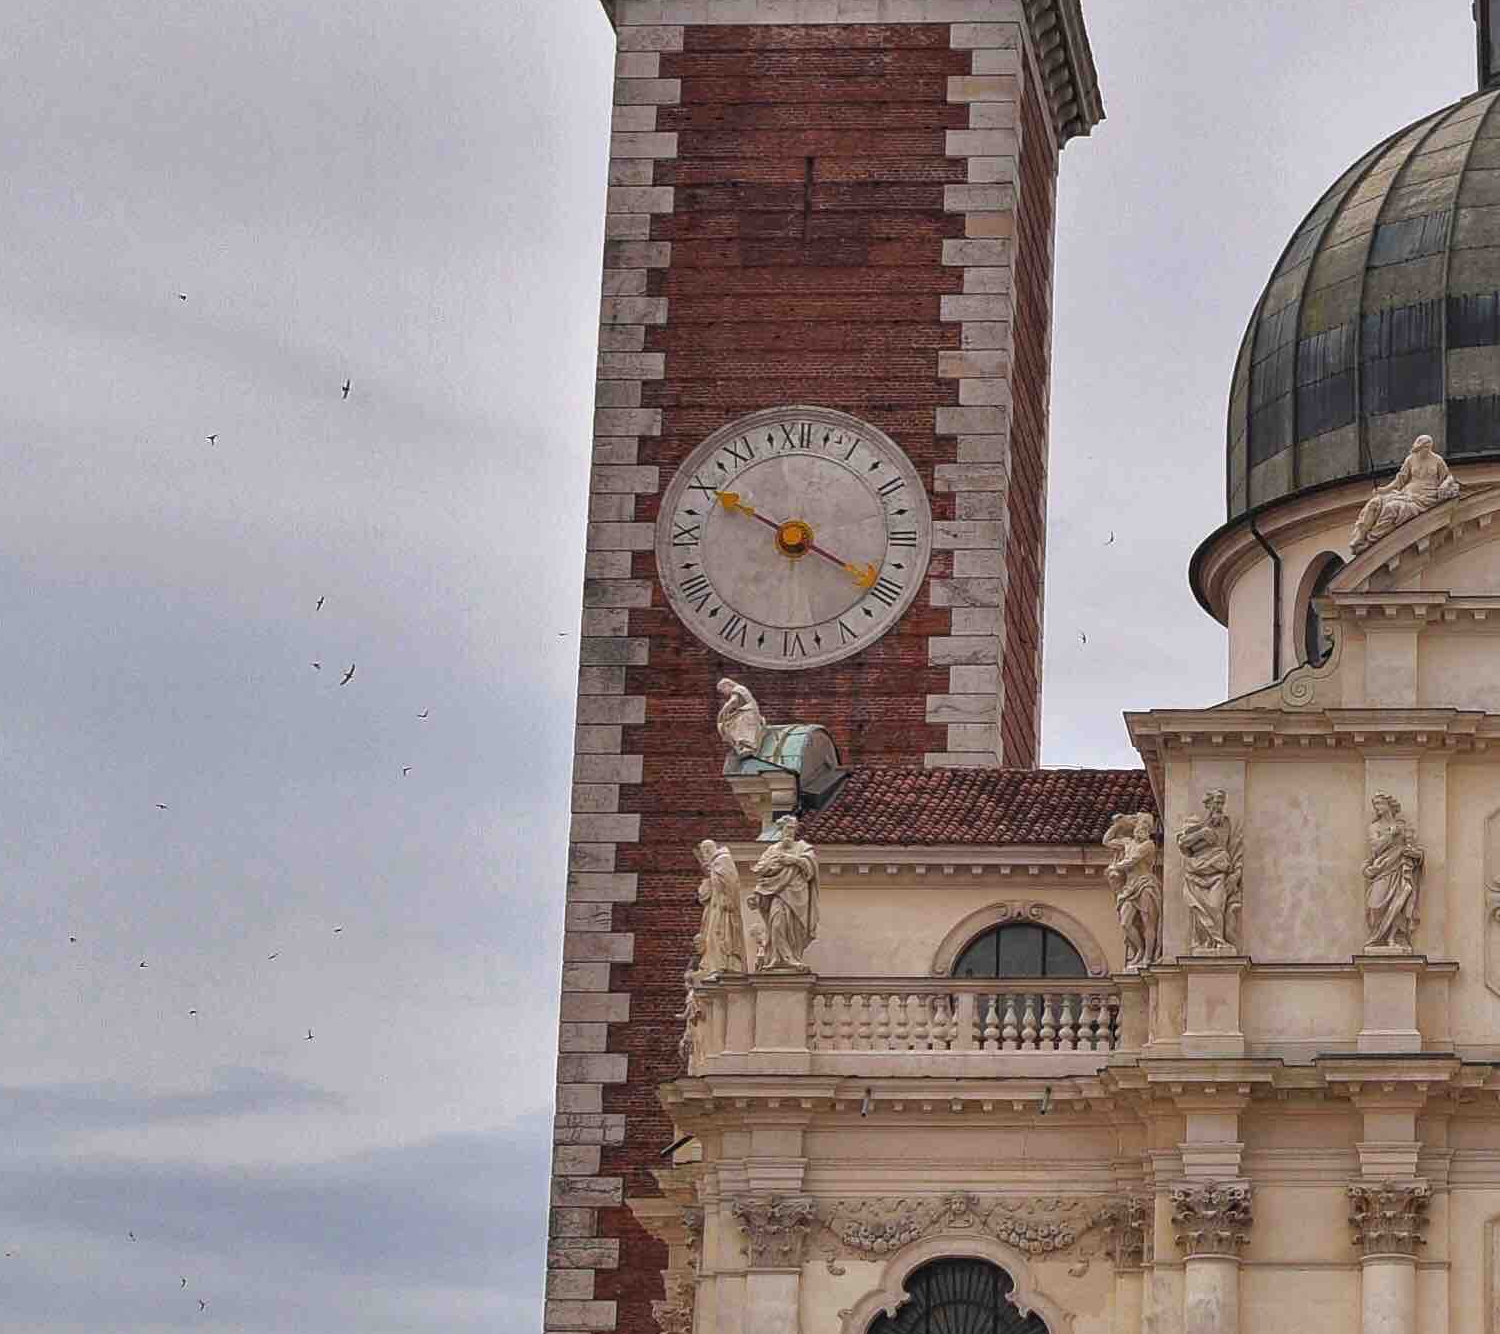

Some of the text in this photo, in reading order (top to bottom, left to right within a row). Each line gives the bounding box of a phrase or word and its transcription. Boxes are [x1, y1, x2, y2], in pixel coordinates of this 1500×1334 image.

[779, 423, 812, 449] XII
[723, 436, 755, 468] XI
[843, 438, 860, 461] I
[687, 474, 717, 501] X
[878, 477, 905, 497] II
[672, 522, 700, 547] IX
[888, 531, 917, 547] III
[680, 574, 713, 614] VIII
[869, 577, 903, 608] IIII
[718, 614, 748, 647] VII
[837, 620, 859, 644] V
[782, 631, 807, 657] VI
